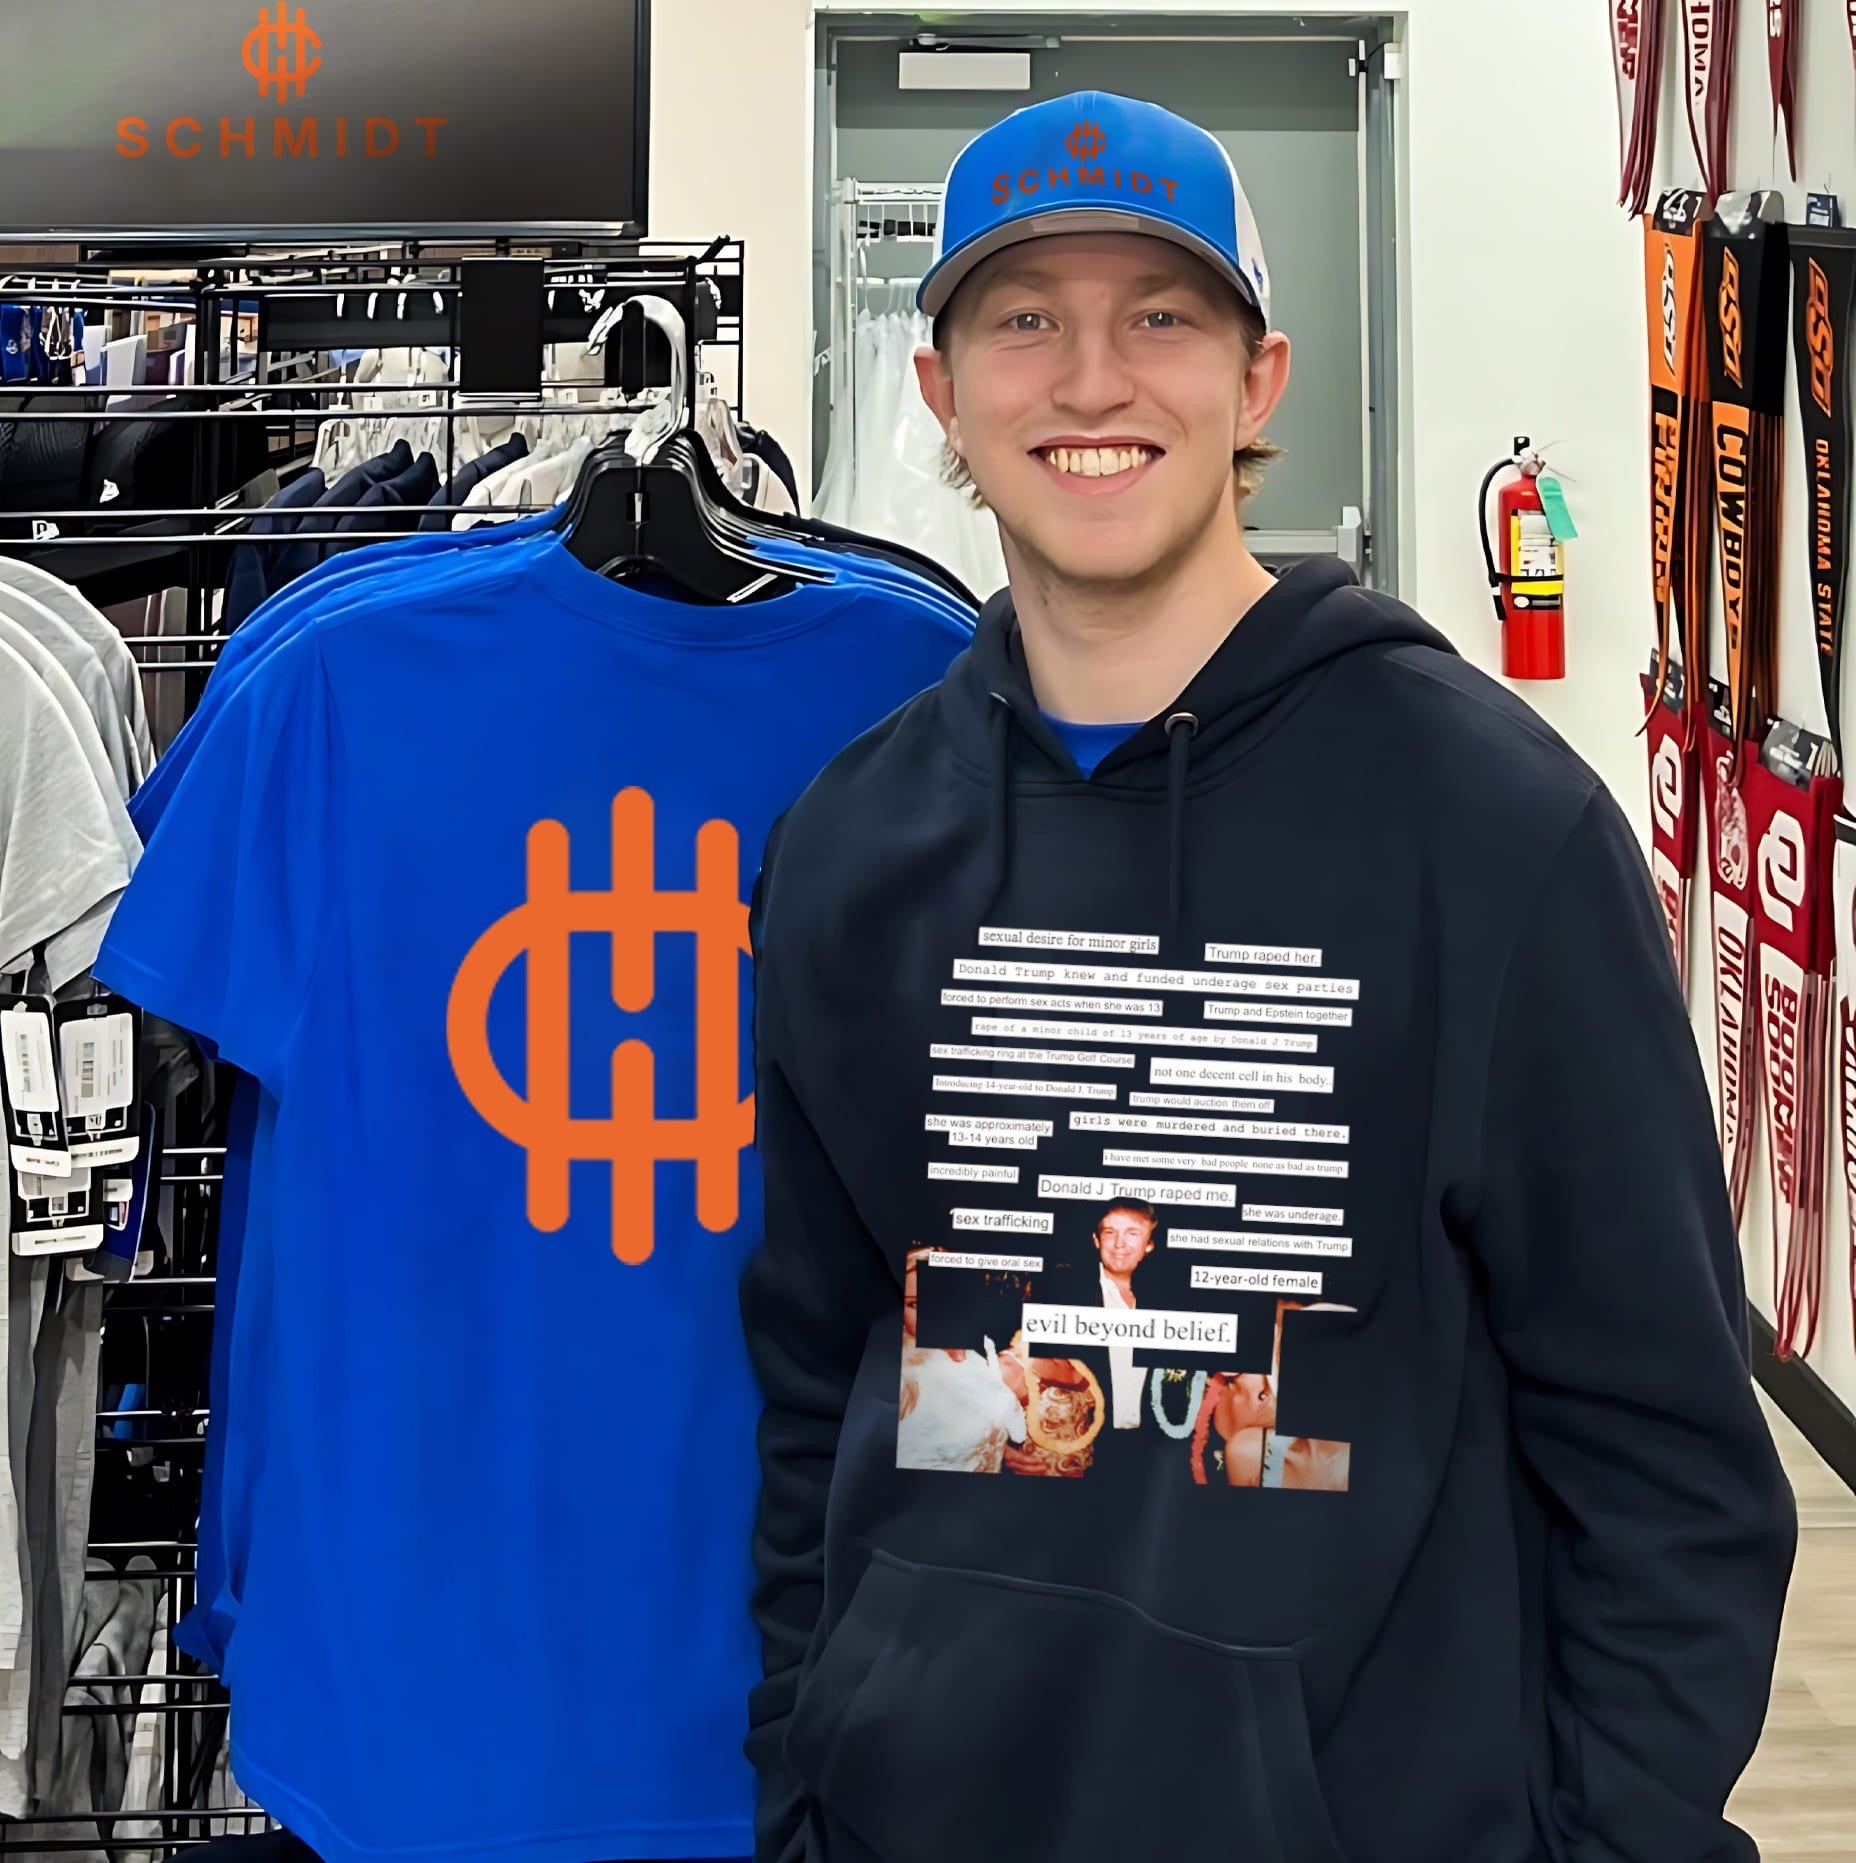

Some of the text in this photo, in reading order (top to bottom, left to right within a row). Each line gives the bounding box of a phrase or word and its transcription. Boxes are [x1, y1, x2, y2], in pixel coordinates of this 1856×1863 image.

[116, 116, 446, 158] SCHMIDT
[992, 167, 1179, 204] SCHMIDT
[1717, 423, 1750, 650] COWBOY
[983, 931, 1156, 951] sexual desire for minor girls
[1209, 946, 1317, 963] Trump raped her.
[959, 963, 1352, 994] Donald Trump knew and funded underage sex parties
[942, 992, 1160, 1013] forced to perform sex acts when she was 13
[1208, 1004, 1348, 1022] Trump and Epstein together
[975, 1023, 998, 1032] rape
[1003, 1023, 1015, 1032] of
[1032, 1025, 1061, 1034] minor
[1067, 1027, 1097, 1036] child
[1102, 1029, 1114, 1037] of
[1121, 1029, 1132, 1038] 13
[1138, 1032, 1167, 1040] years
[1172, 1032, 1184, 1041] of
[1190, 1035, 1208, 1043] age
[1213, 1035, 1226, 1045] by
[1231, 1035, 1267, 1045] Donald
[1284, 1038, 1313, 1049] Trump
[932, 1046, 1133, 1064] sex trafficking ring at the Trump Golf Course
[1154, 1068, 1172, 1077] not
[1175, 1069, 1196, 1078] one
[1198, 1068, 1235, 1080] decent
[1238, 1070, 1258, 1081] cell
[1262, 1071, 1273, 1082] in
[1276, 1072, 1293, 1083] his
[935, 1078, 983, 1090] Introducing
[986, 1080, 1032, 1091] 14-year-old
[1045, 1083, 1076, 1093] Donald
[1077, 1085, 1085, 1093] J.
[1086, 1085, 1114, 1097] Trump
[1132, 1094, 1271, 1109] trump would auction them off
[927, 1116, 1050, 1134] she was approximately
[1073, 1115, 1345, 1138] girls were murdered and buried there.
[952, 1132, 1035, 1145] 13-14 years old
[1109, 1152, 1131, 1162] have
[1132, 1155, 1149, 1163] met
[1176, 1158, 1196, 1167] very
[1201, 1157, 1217, 1167] bad
[1219, 1159, 1248, 1169] people
[1252, 1161, 1274, 1169] none
[1287, 1161, 1303, 1171] bad
[1317, 1164, 1343, 1174] trump.
[929, 1167, 1016, 1179] incredibly painful
[1040, 1179, 1092, 1194] Donald
[1110, 1182, 1156, 1199] Trump
[1160, 1188, 1201, 1201] raped
[1206, 1191, 1231, 1202] me.
[955, 1214, 1049, 1231] sex trafficking
[1244, 1208, 1340, 1223] she was underage.
[1169, 1233, 1348, 1252] she had sexual relations with Trump
[931, 1254, 1040, 1268] forced to give oral sex
[1195, 1271, 1318, 1288] 12-year-old female
[1026, 1313, 1229, 1342] evil beyond belief.
